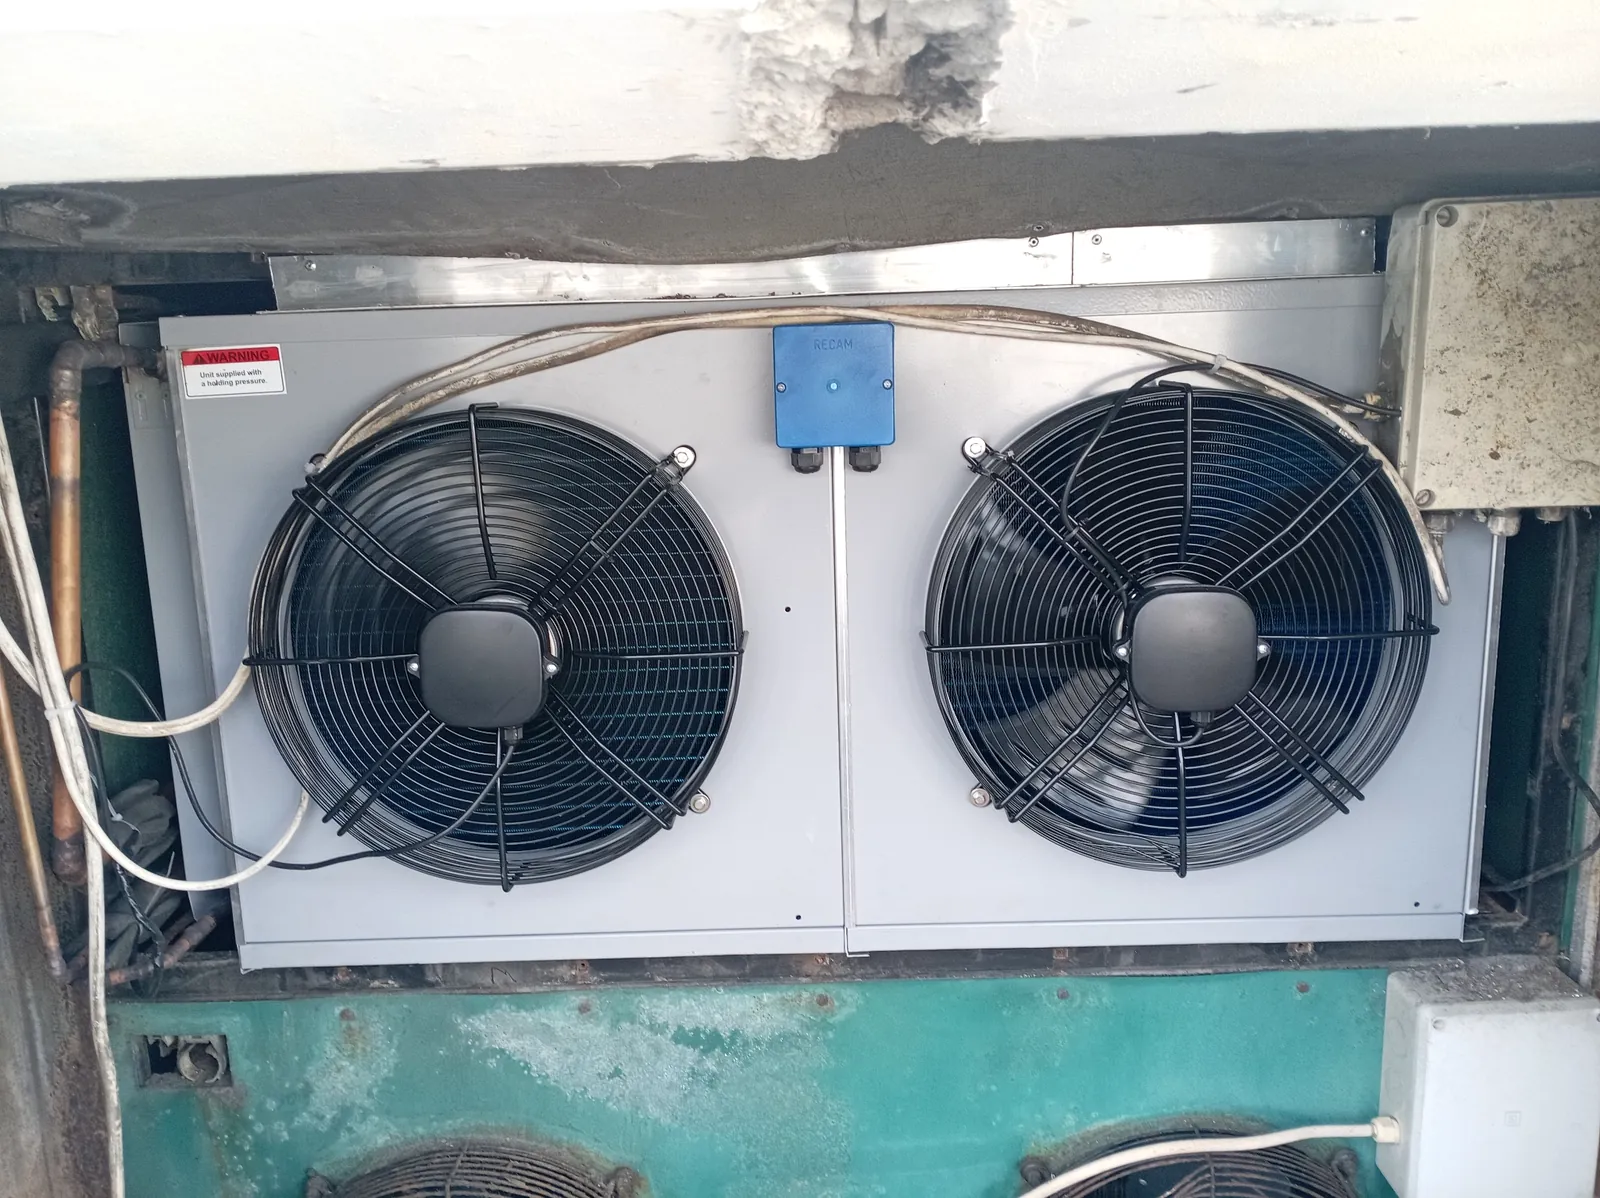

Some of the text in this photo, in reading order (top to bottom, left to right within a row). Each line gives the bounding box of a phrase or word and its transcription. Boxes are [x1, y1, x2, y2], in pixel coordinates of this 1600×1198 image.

[814, 338, 853, 350] RECAM
[206, 350, 270, 363] WARNING
[216, 369, 246, 378] supplied
[247, 368, 262, 376] with
[207, 379, 233, 387] holding
[235, 378, 268, 386] pressure.
